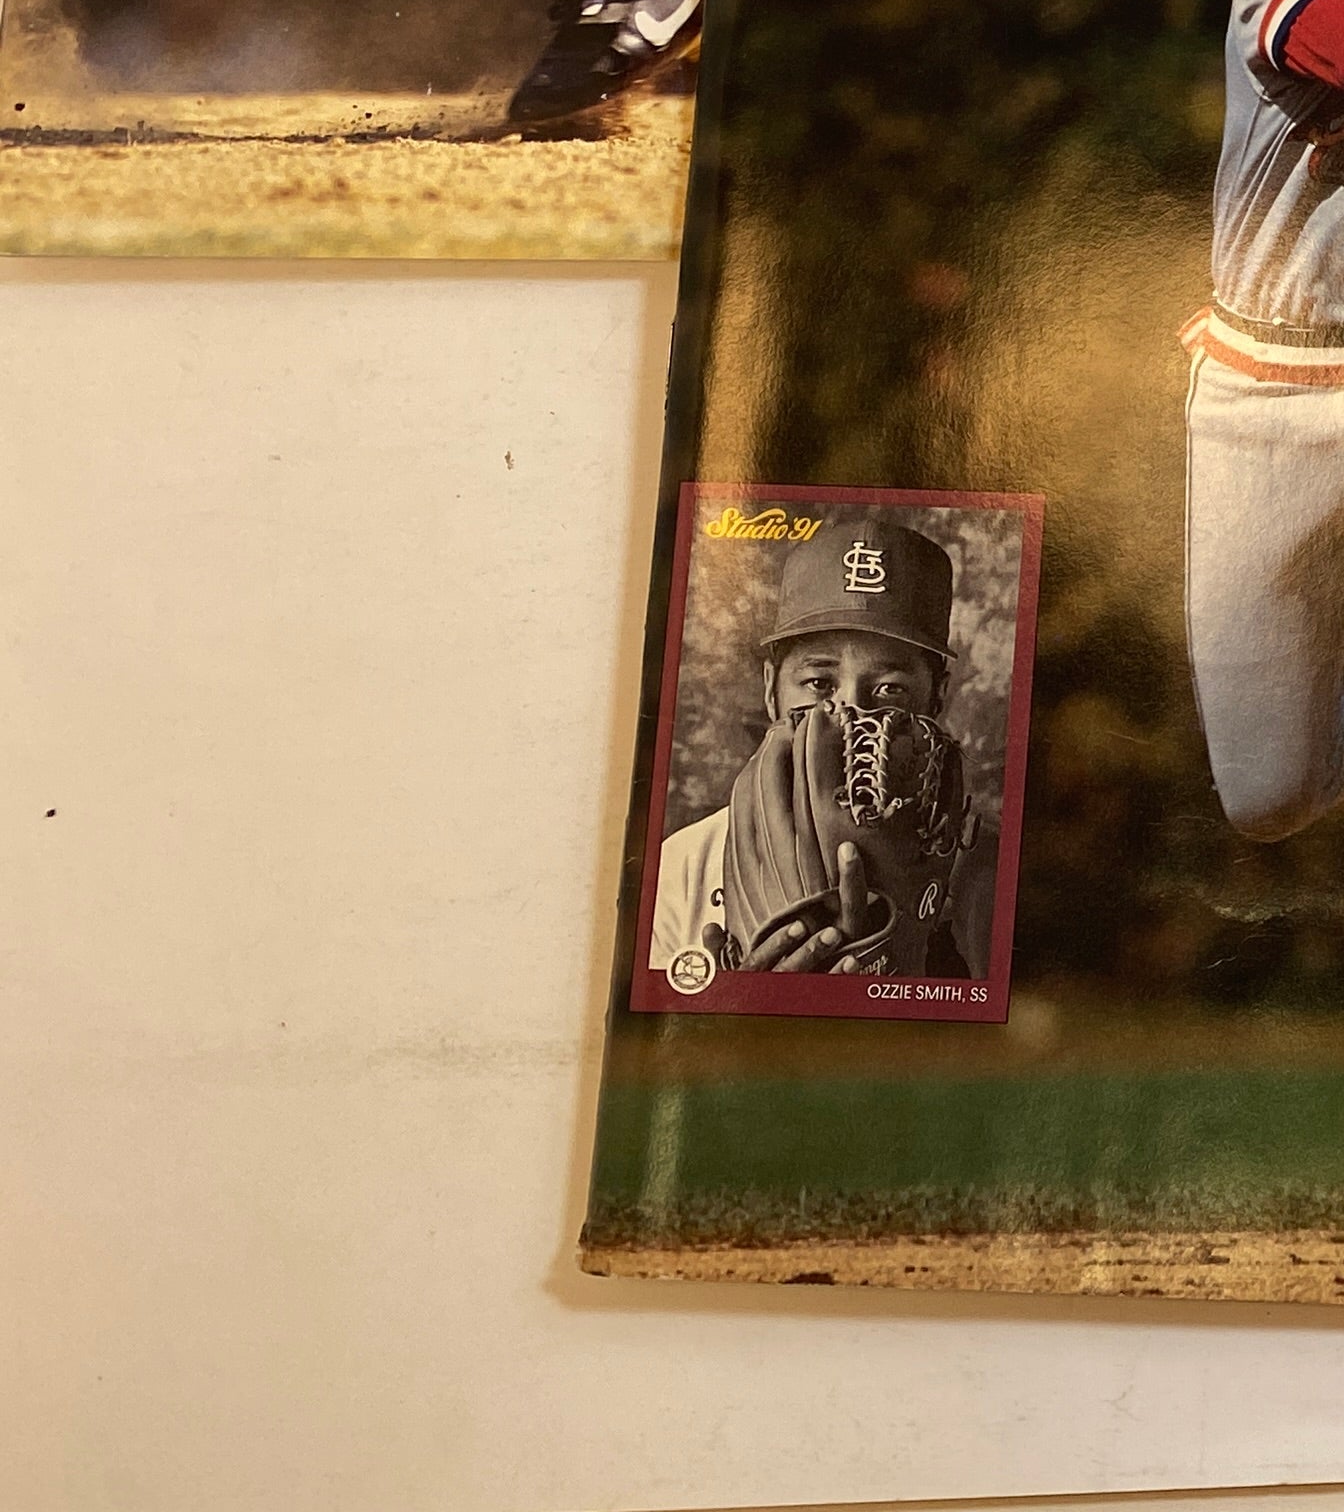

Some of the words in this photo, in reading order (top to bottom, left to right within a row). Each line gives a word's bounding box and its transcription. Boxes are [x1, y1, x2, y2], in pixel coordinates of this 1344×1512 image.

[705, 508, 787, 539] Studio
[867, 983, 912, 1000] OZZIE
[915, 985, 966, 1003] SMITH,
[969, 987, 988, 1002] SS
